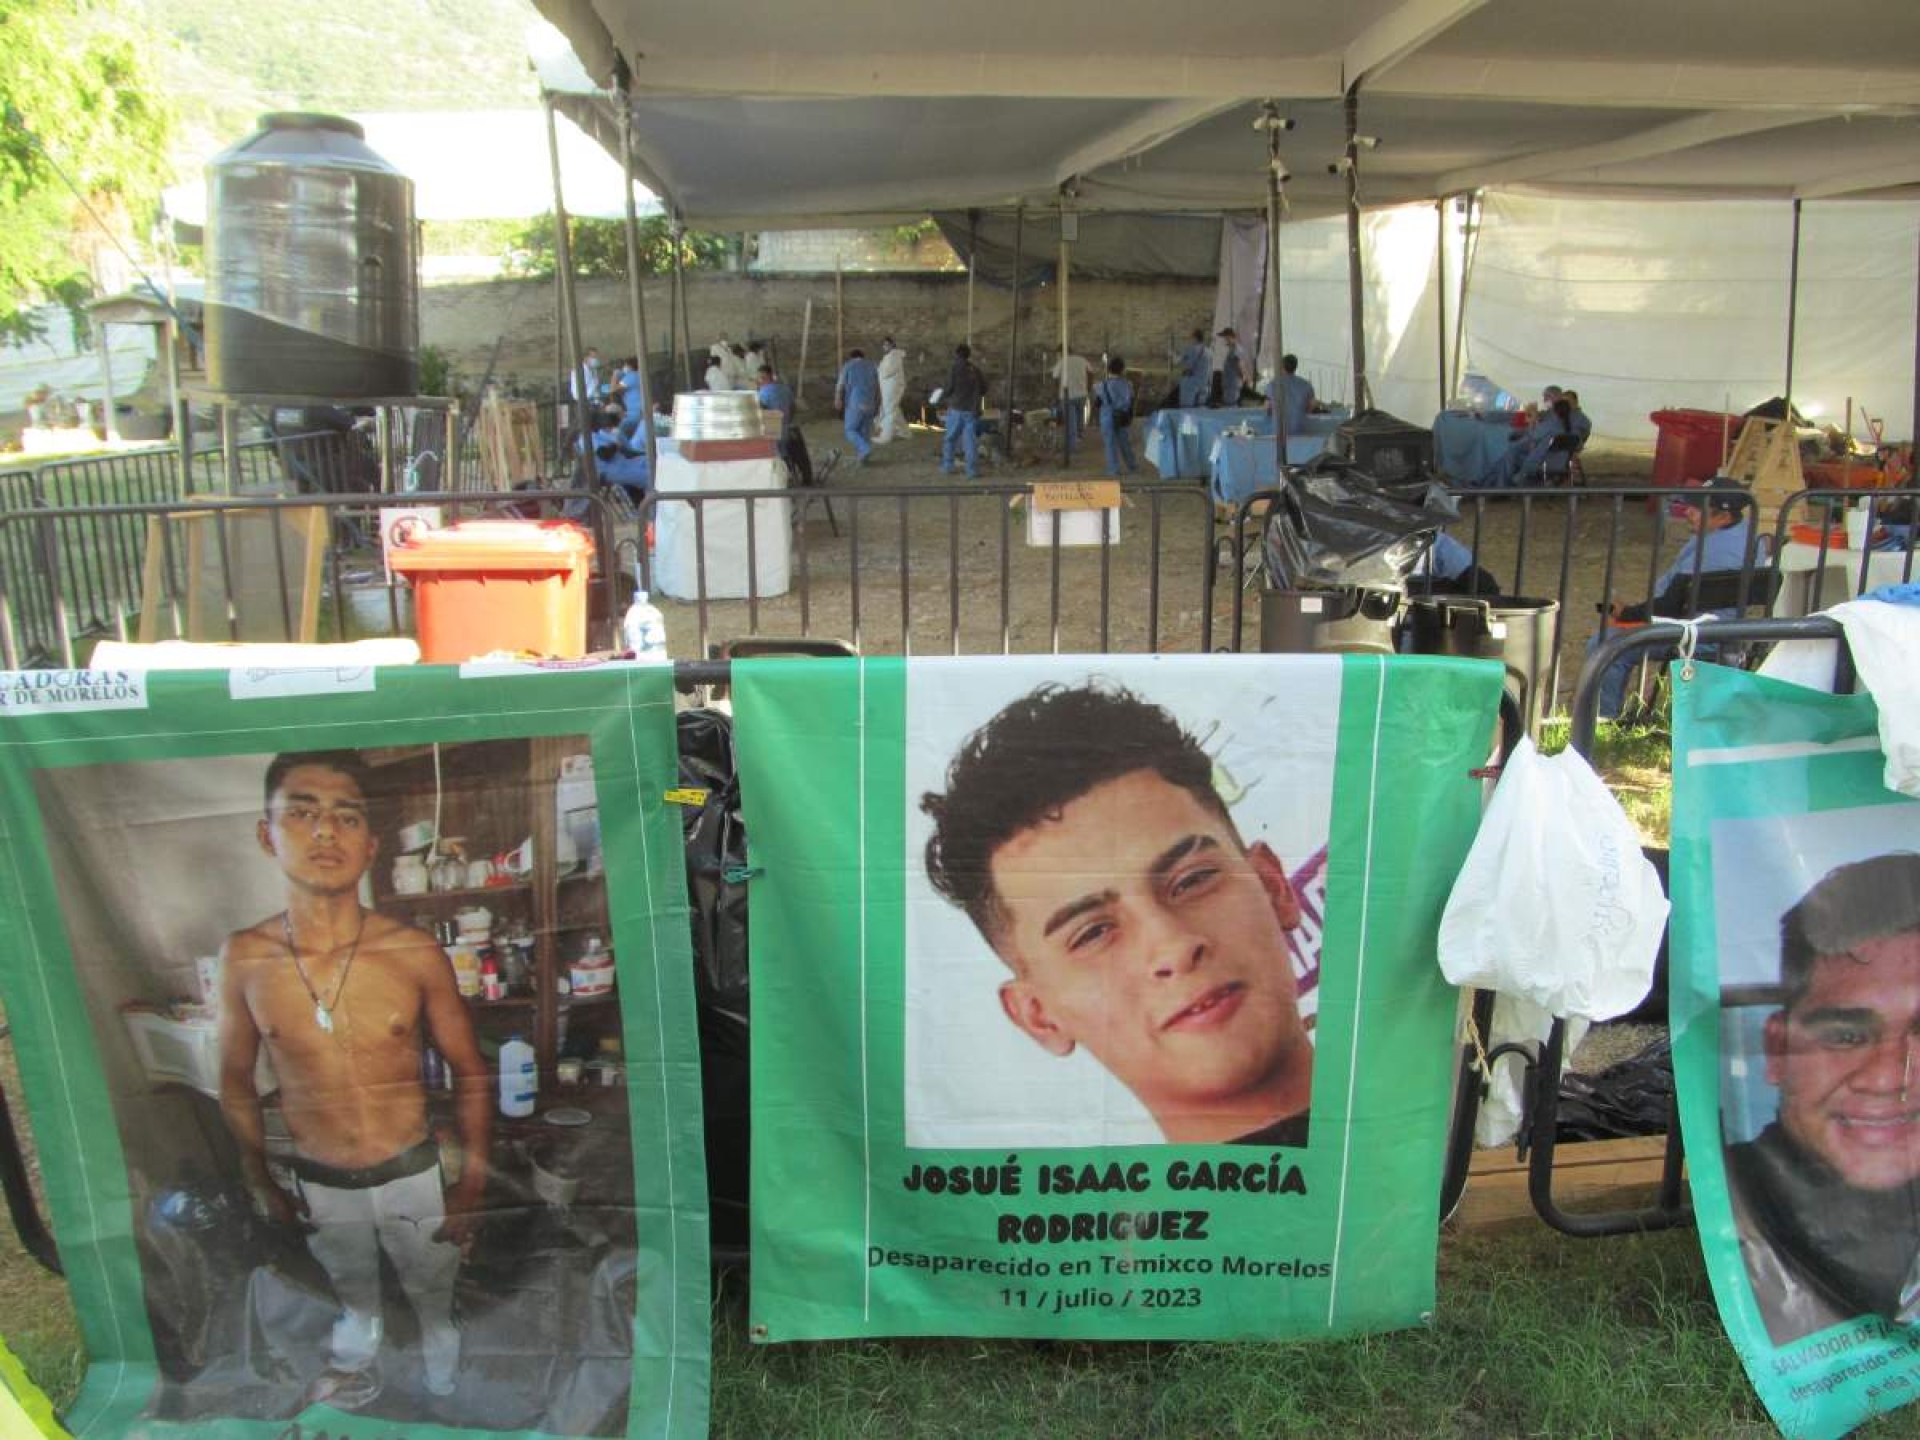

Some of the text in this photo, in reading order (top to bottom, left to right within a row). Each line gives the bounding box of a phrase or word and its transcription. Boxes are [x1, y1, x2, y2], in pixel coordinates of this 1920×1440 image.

[16, 689, 40, 705] DE
[46, 685, 139, 703] MORELOS
[903, 1153, 1307, 1196] JOSUÉ ISAAC GARCÍA
[998, 1211, 1209, 1244] RODRIGUEZ
[868, 1246, 1331, 1278] Desaparecido en Temixco Morelos
[1001, 1287, 1202, 1315] 11 / julio / 2023
[1771, 1332, 1853, 1377] SALVADOR
[1854, 1322, 1877, 1345] DE
[1789, 1354, 1888, 1401] desaparecido
